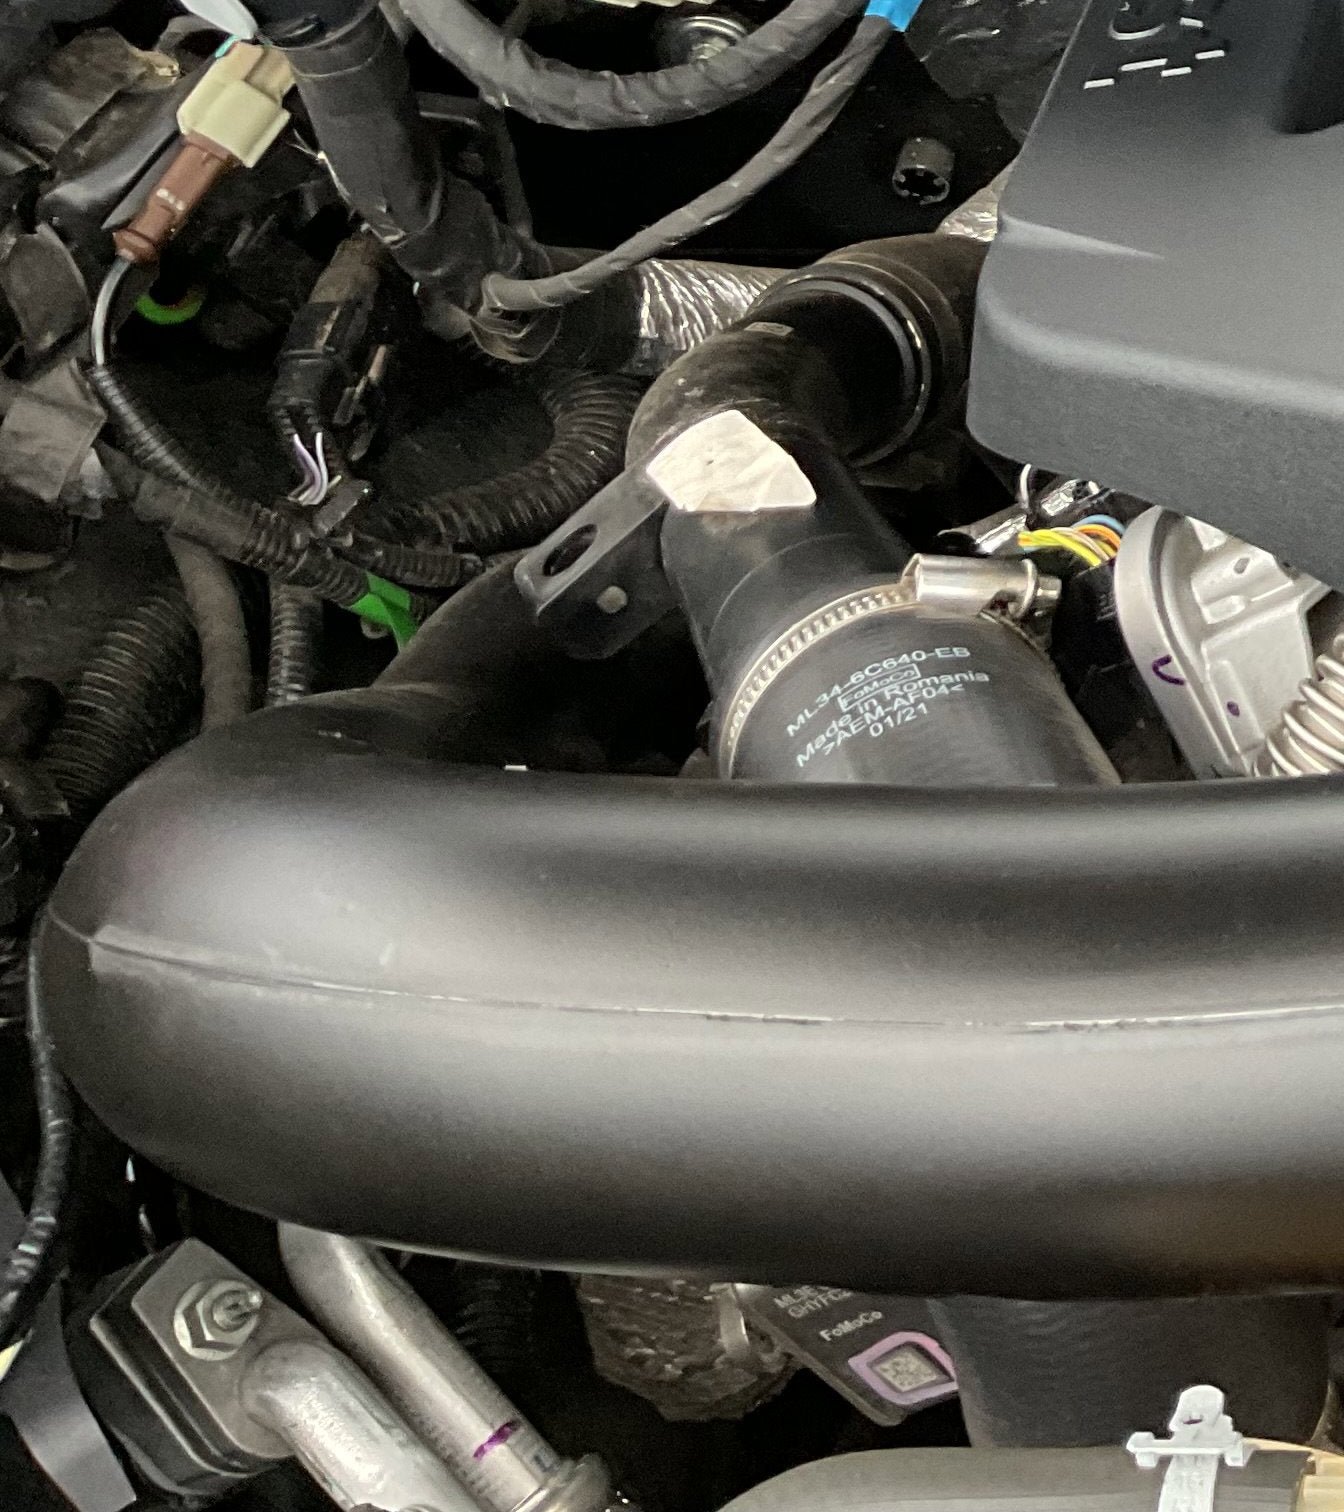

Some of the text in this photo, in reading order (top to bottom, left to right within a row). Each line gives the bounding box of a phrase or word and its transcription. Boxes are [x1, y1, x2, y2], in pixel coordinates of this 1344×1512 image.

[796, 670, 990, 767] Made in Romania
[869, 702, 928, 738] 01/21
